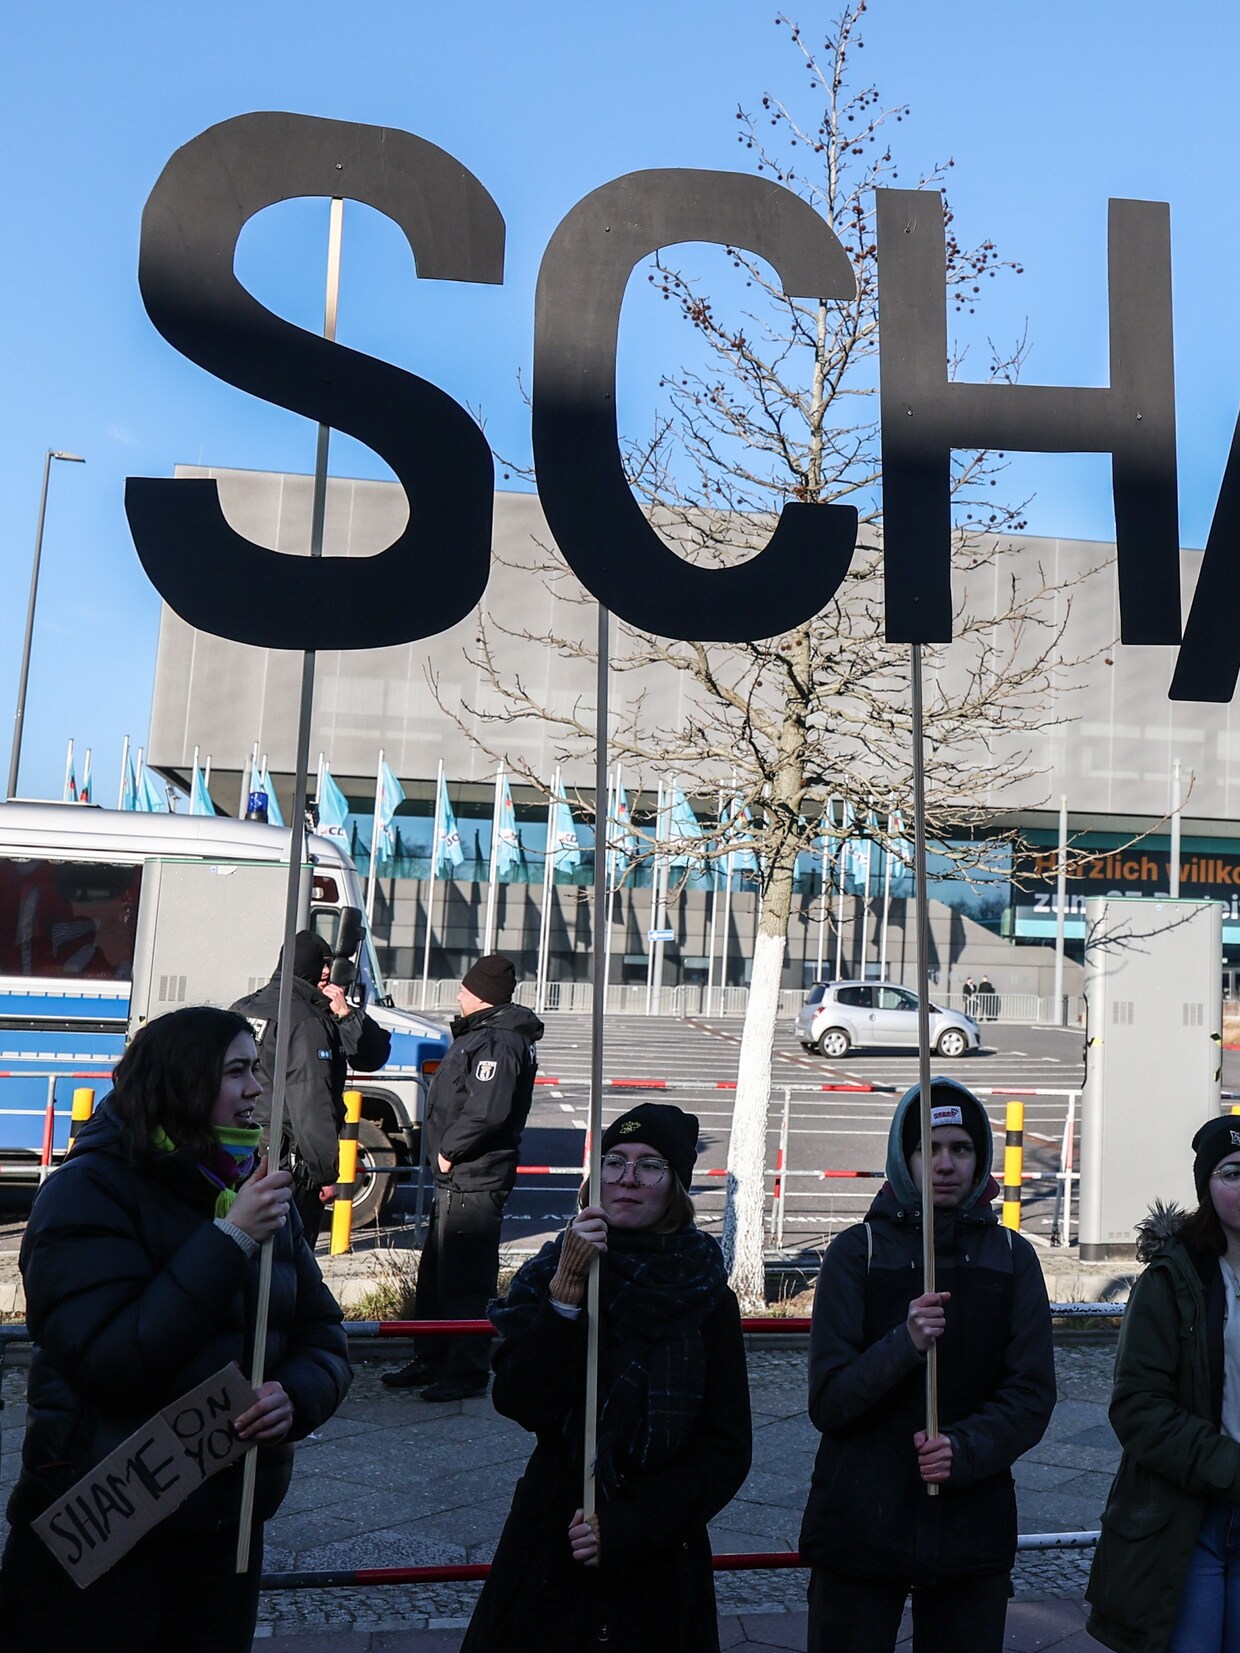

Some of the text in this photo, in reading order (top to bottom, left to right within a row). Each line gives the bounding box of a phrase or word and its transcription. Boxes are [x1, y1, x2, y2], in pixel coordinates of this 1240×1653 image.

[1036, 853, 1158, 881] Hrzlich
[173, 1387, 231, 1438] ON
[49, 1437, 181, 1565] SHAME
